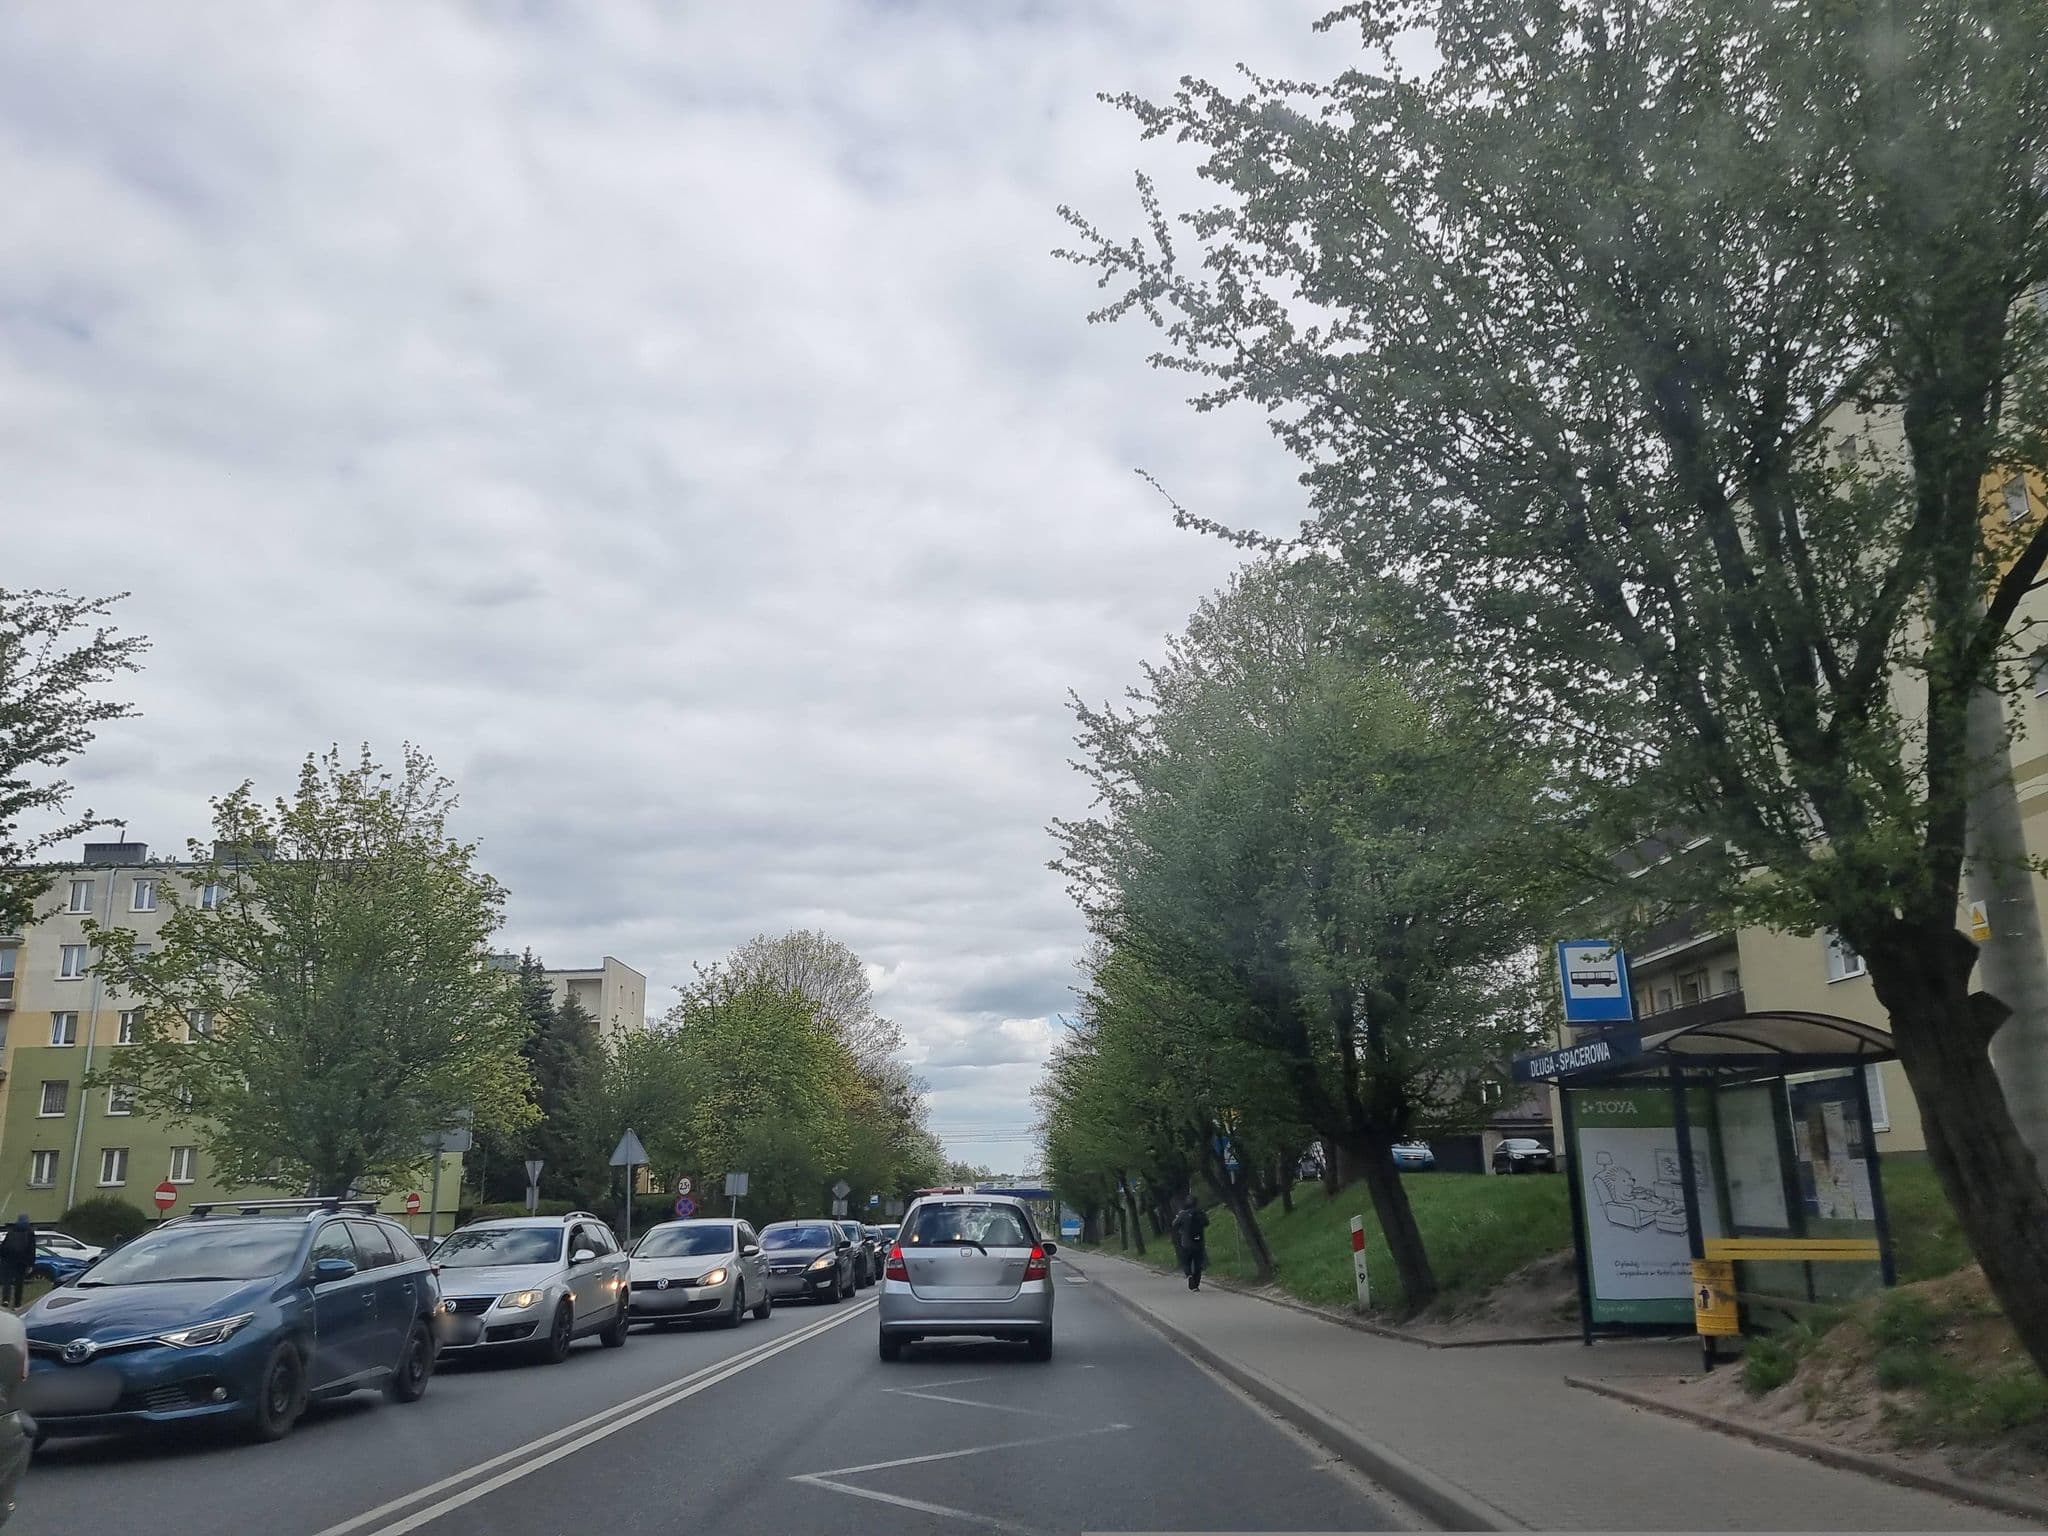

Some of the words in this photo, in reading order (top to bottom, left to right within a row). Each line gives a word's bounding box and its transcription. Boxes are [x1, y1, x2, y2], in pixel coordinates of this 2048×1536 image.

[1530, 1056, 1555, 1077] DŁUGA
[1560, 1042, 1611, 1071] SPACEROWA
[1596, 1101, 1637, 1114] TOYA
[1359, 1273, 1365, 1284] 9
